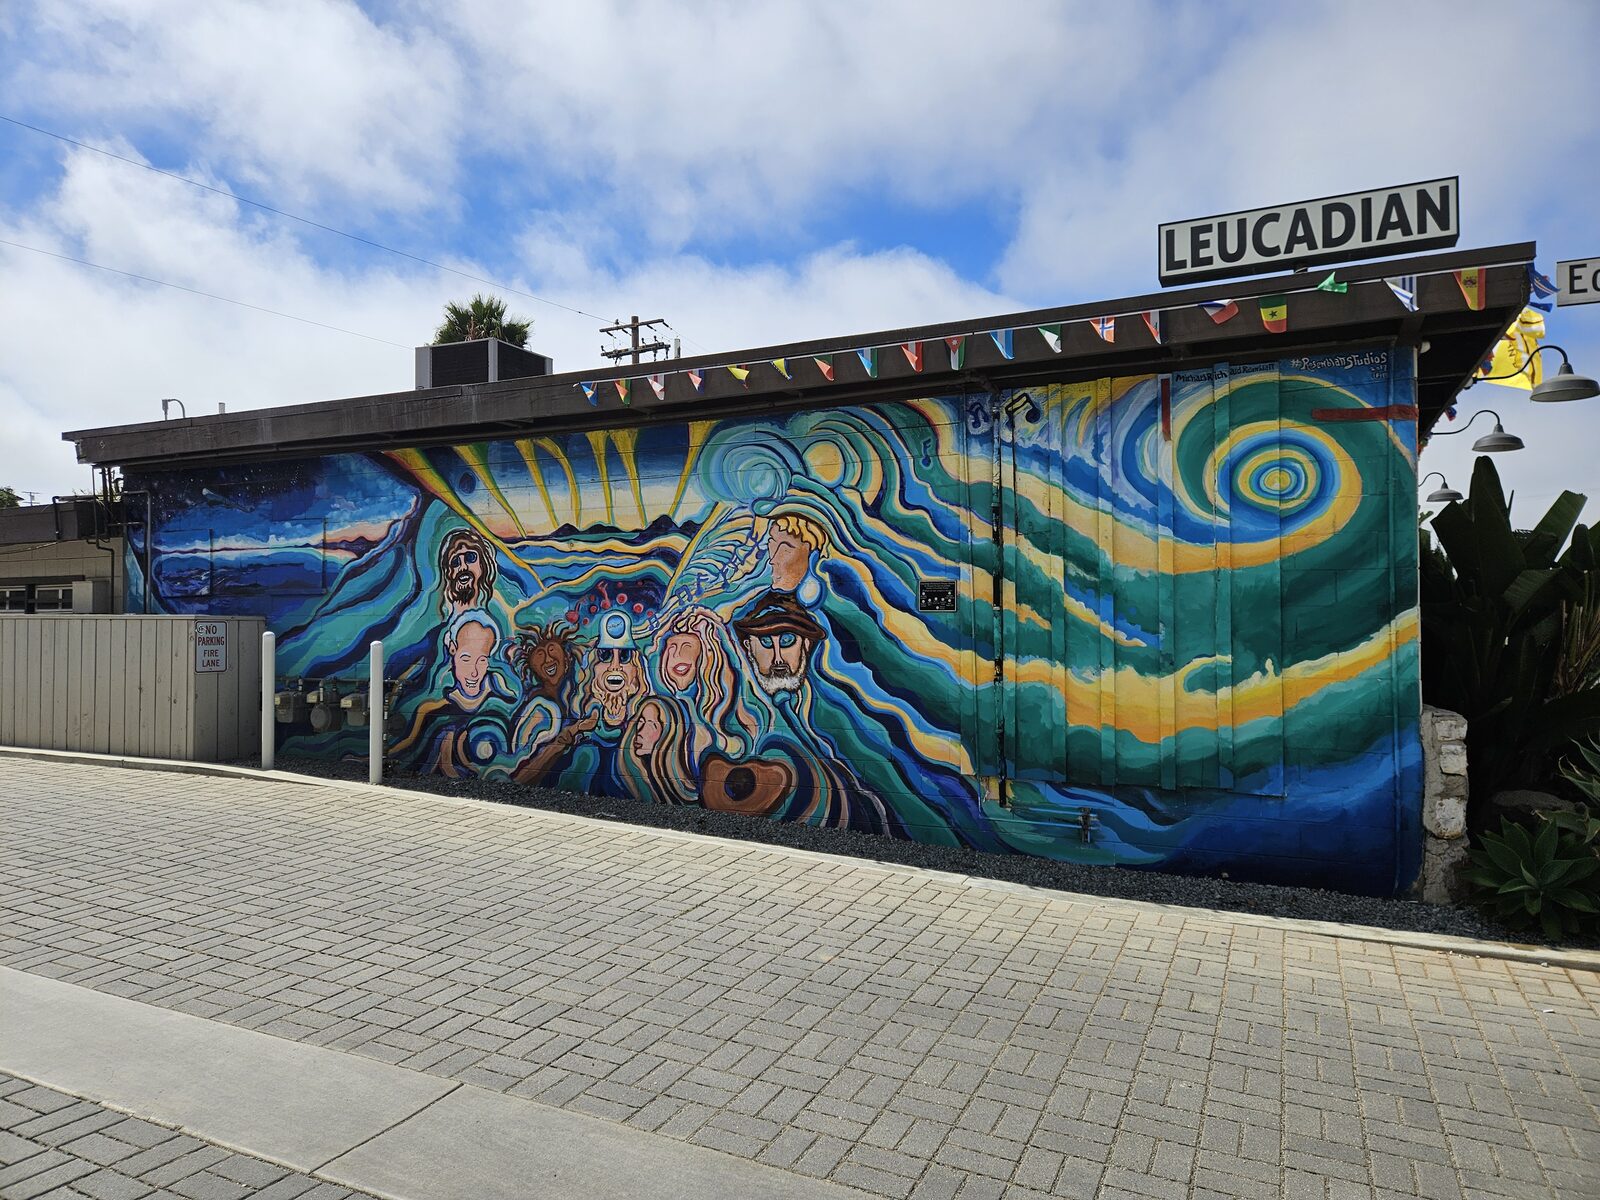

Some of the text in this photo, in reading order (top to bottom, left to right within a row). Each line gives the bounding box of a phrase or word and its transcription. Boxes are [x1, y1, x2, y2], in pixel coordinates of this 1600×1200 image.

[1165, 185, 1451, 271] LEUCADIAN
[205, 625, 217, 635] NO
[197, 636, 225, 646] PARKING
[203, 649, 219, 657] FIRE
[202, 659, 220, 667] LANE
